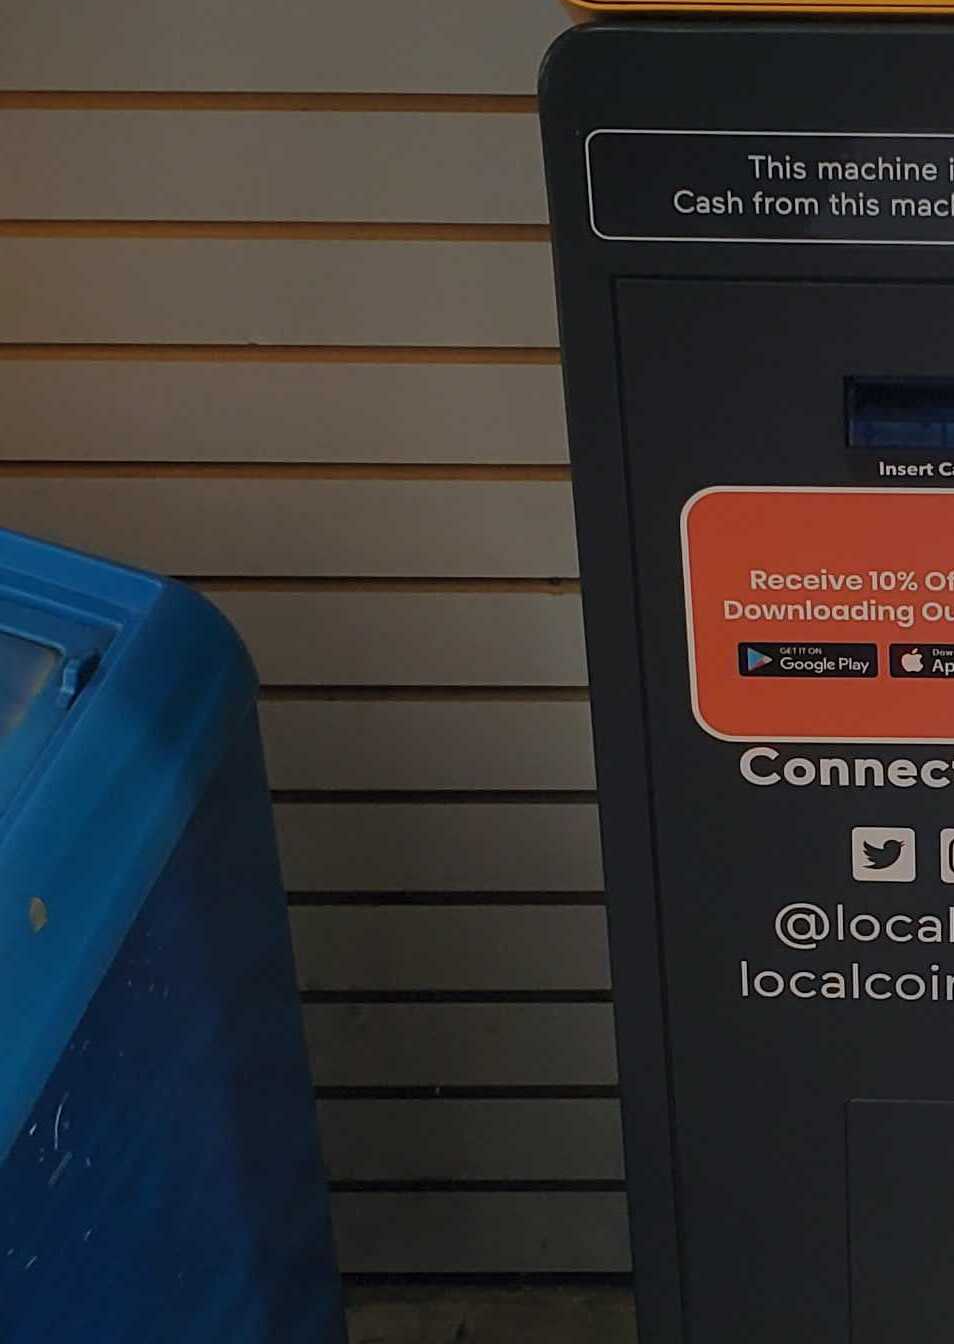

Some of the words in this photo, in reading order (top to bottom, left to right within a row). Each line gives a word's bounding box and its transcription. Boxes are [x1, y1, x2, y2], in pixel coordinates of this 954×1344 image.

[747, 155, 808, 180] This
[817, 156, 939, 181] machine
[672, 189, 744, 215] Cash
[752, 191, 819, 216] from
[828, 192, 881, 217] this
[878, 461, 935, 477] Insert
[749, 568, 864, 591] Receive
[868, 570, 919, 591] 10%
[722, 600, 915, 627] Downloading
[779, 646, 797, 655] GET
[808, 647, 822, 655] ON
[780, 657, 836, 673] Google
[838, 657, 870, 673] Play
